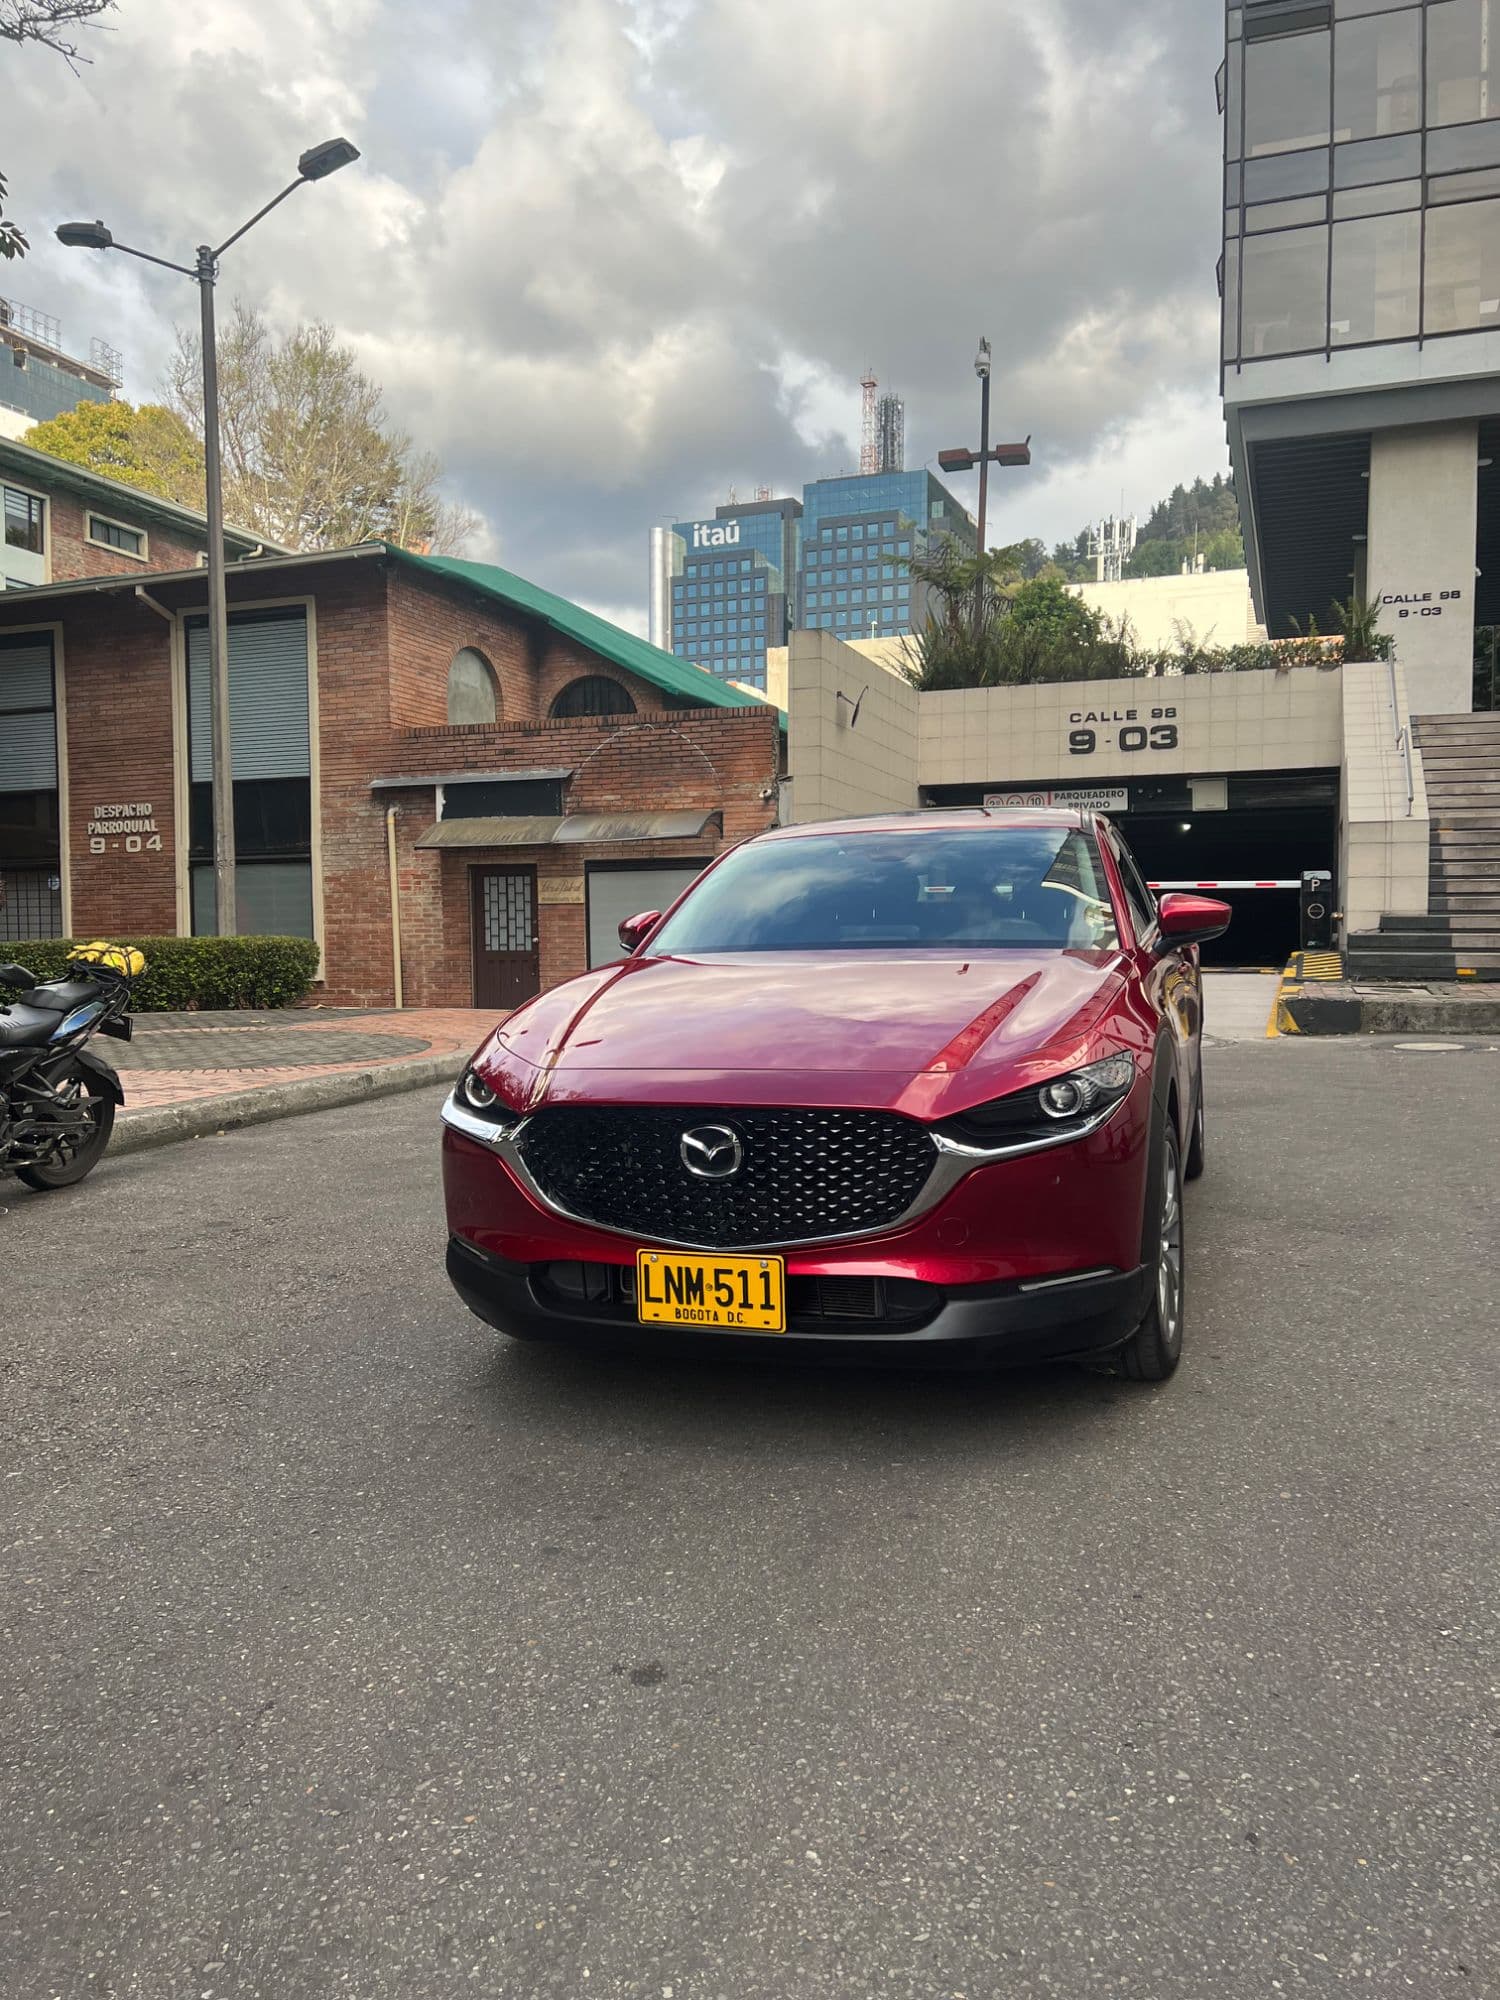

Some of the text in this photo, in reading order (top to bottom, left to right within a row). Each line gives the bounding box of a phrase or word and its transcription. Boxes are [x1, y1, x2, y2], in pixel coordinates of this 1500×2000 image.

[693, 520, 740, 548] itaú
[1382, 590, 1461, 604] CALLE 98
[1069, 707, 1177, 723] CALLE 98
[1054, 790, 1125, 800] PARQUEADERO
[94, 803, 153, 819] DESPACHO
[87, 819, 159, 835] PARROQUIAL
[1311, 879, 1321, 892] P
[643, 1263, 776, 1311] LNM 511
[675, 1307, 719, 1322] BOGOTA
